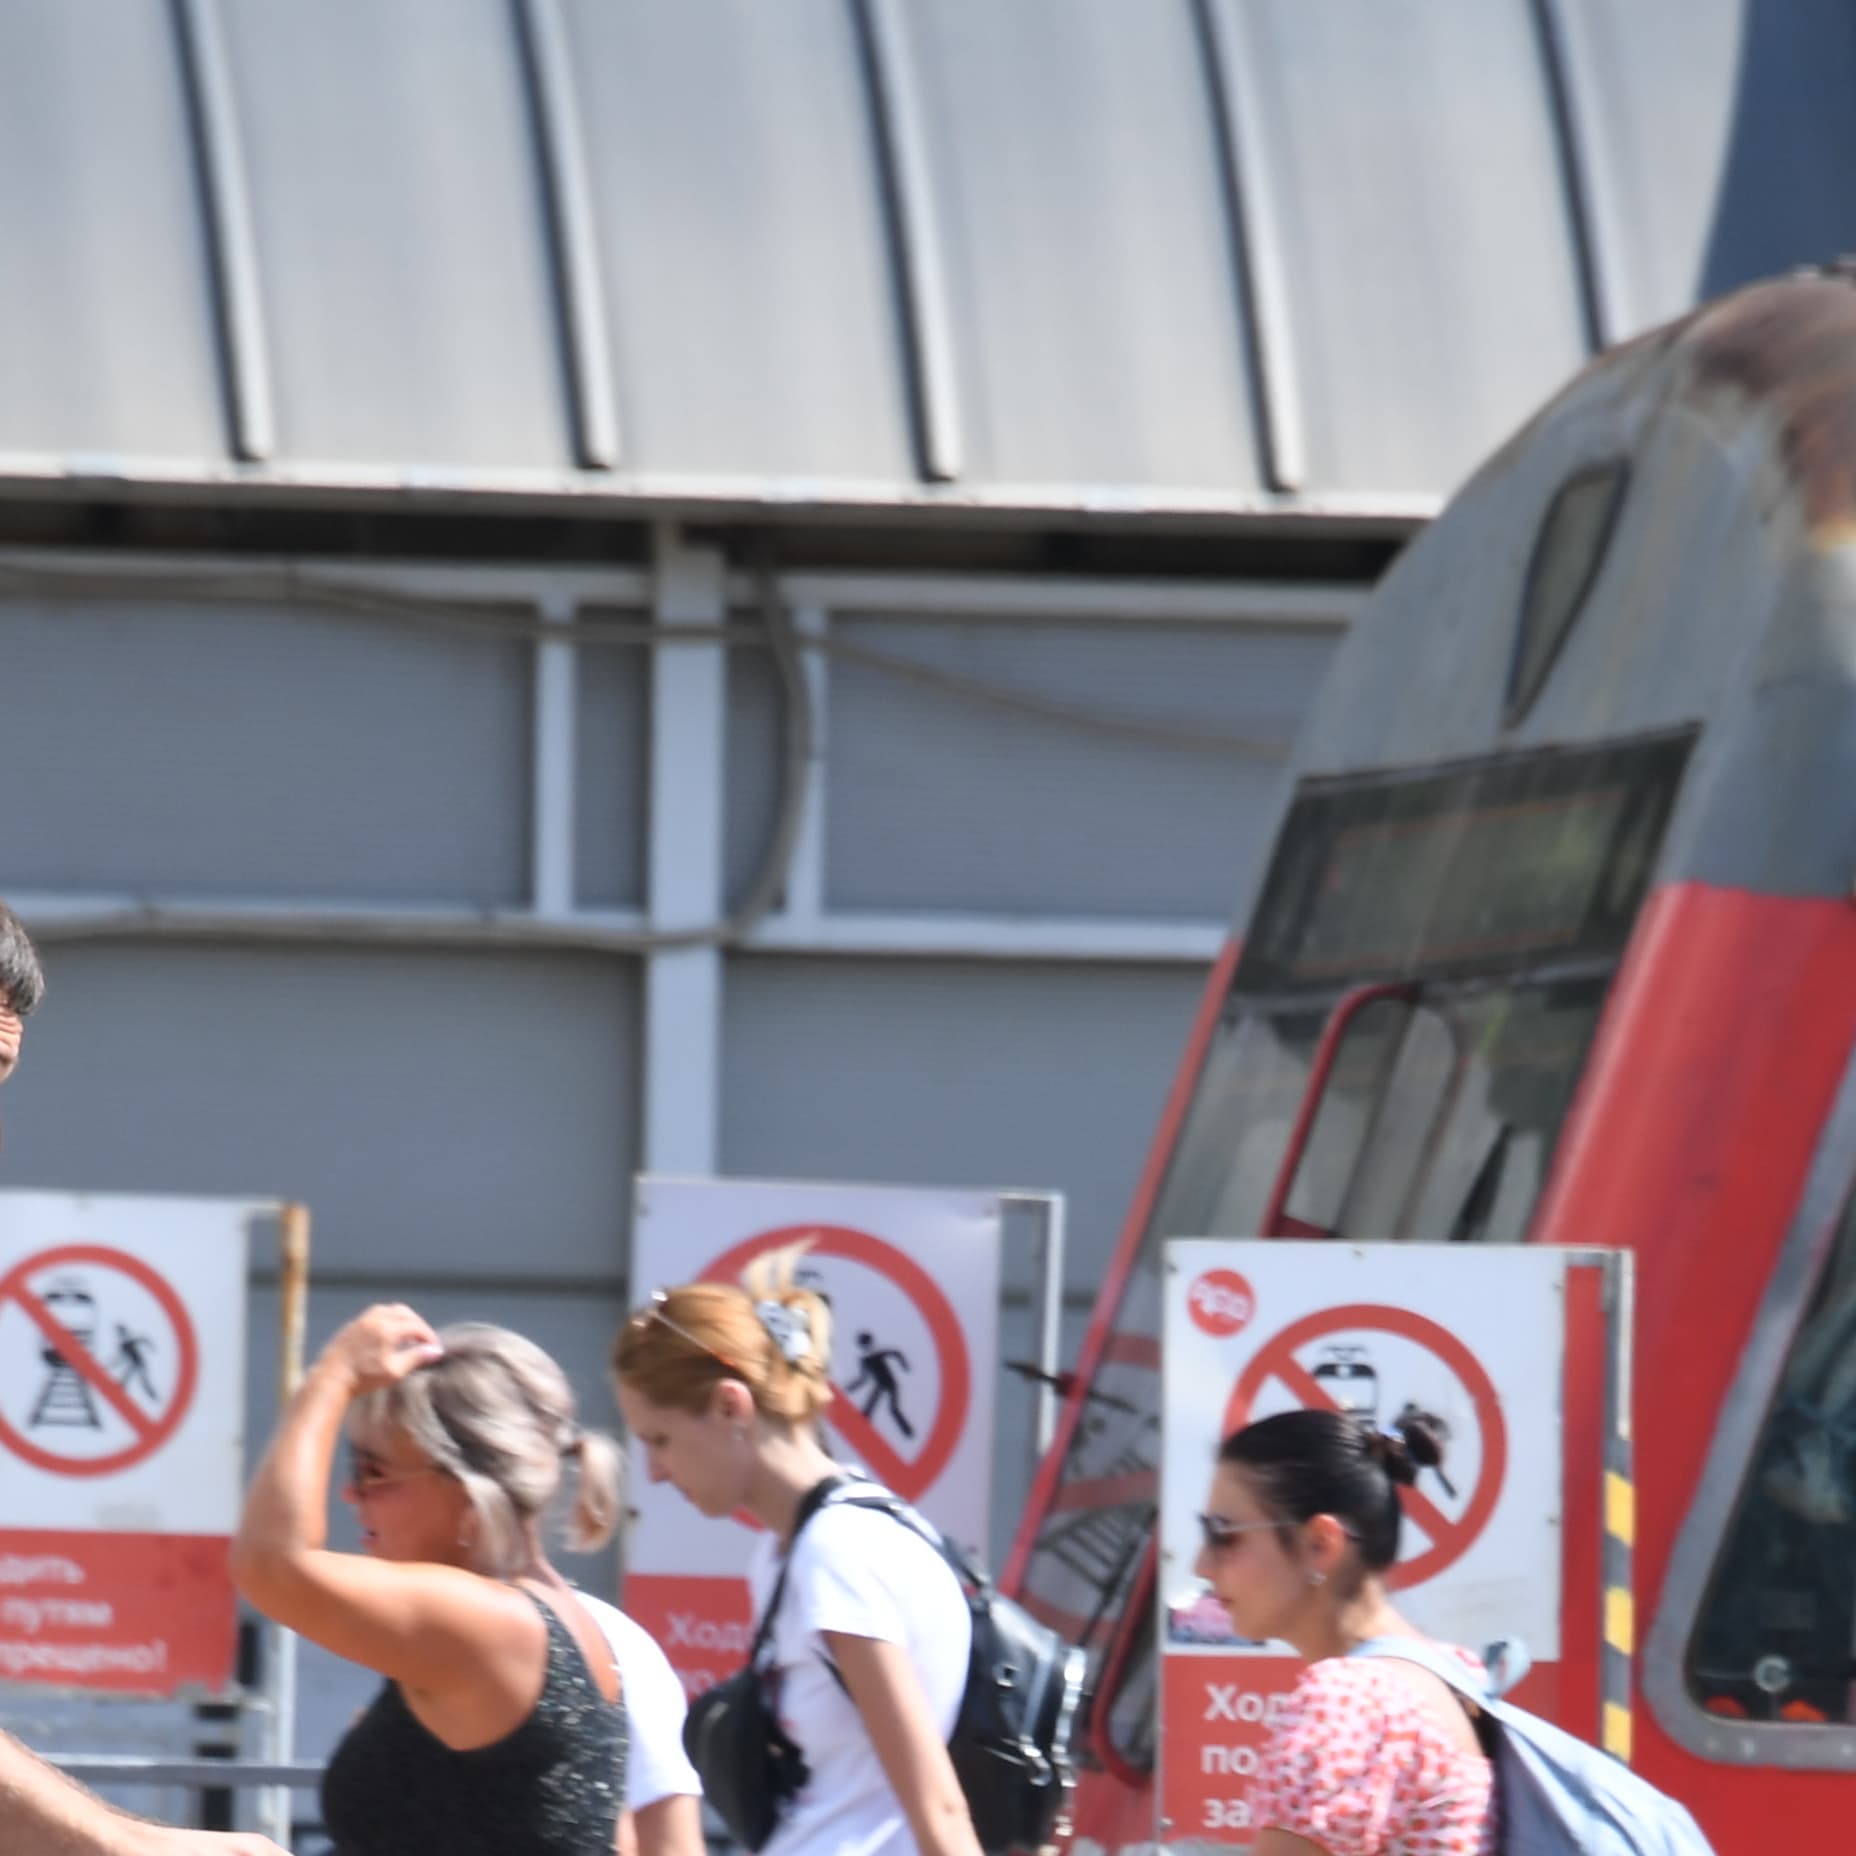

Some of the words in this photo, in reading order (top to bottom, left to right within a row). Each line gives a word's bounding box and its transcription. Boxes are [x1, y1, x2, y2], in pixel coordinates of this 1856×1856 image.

[2, 1596, 113, 1633] путям
[666, 1613, 751, 1654] Ход
[1200, 1744, 1260, 1774] по
